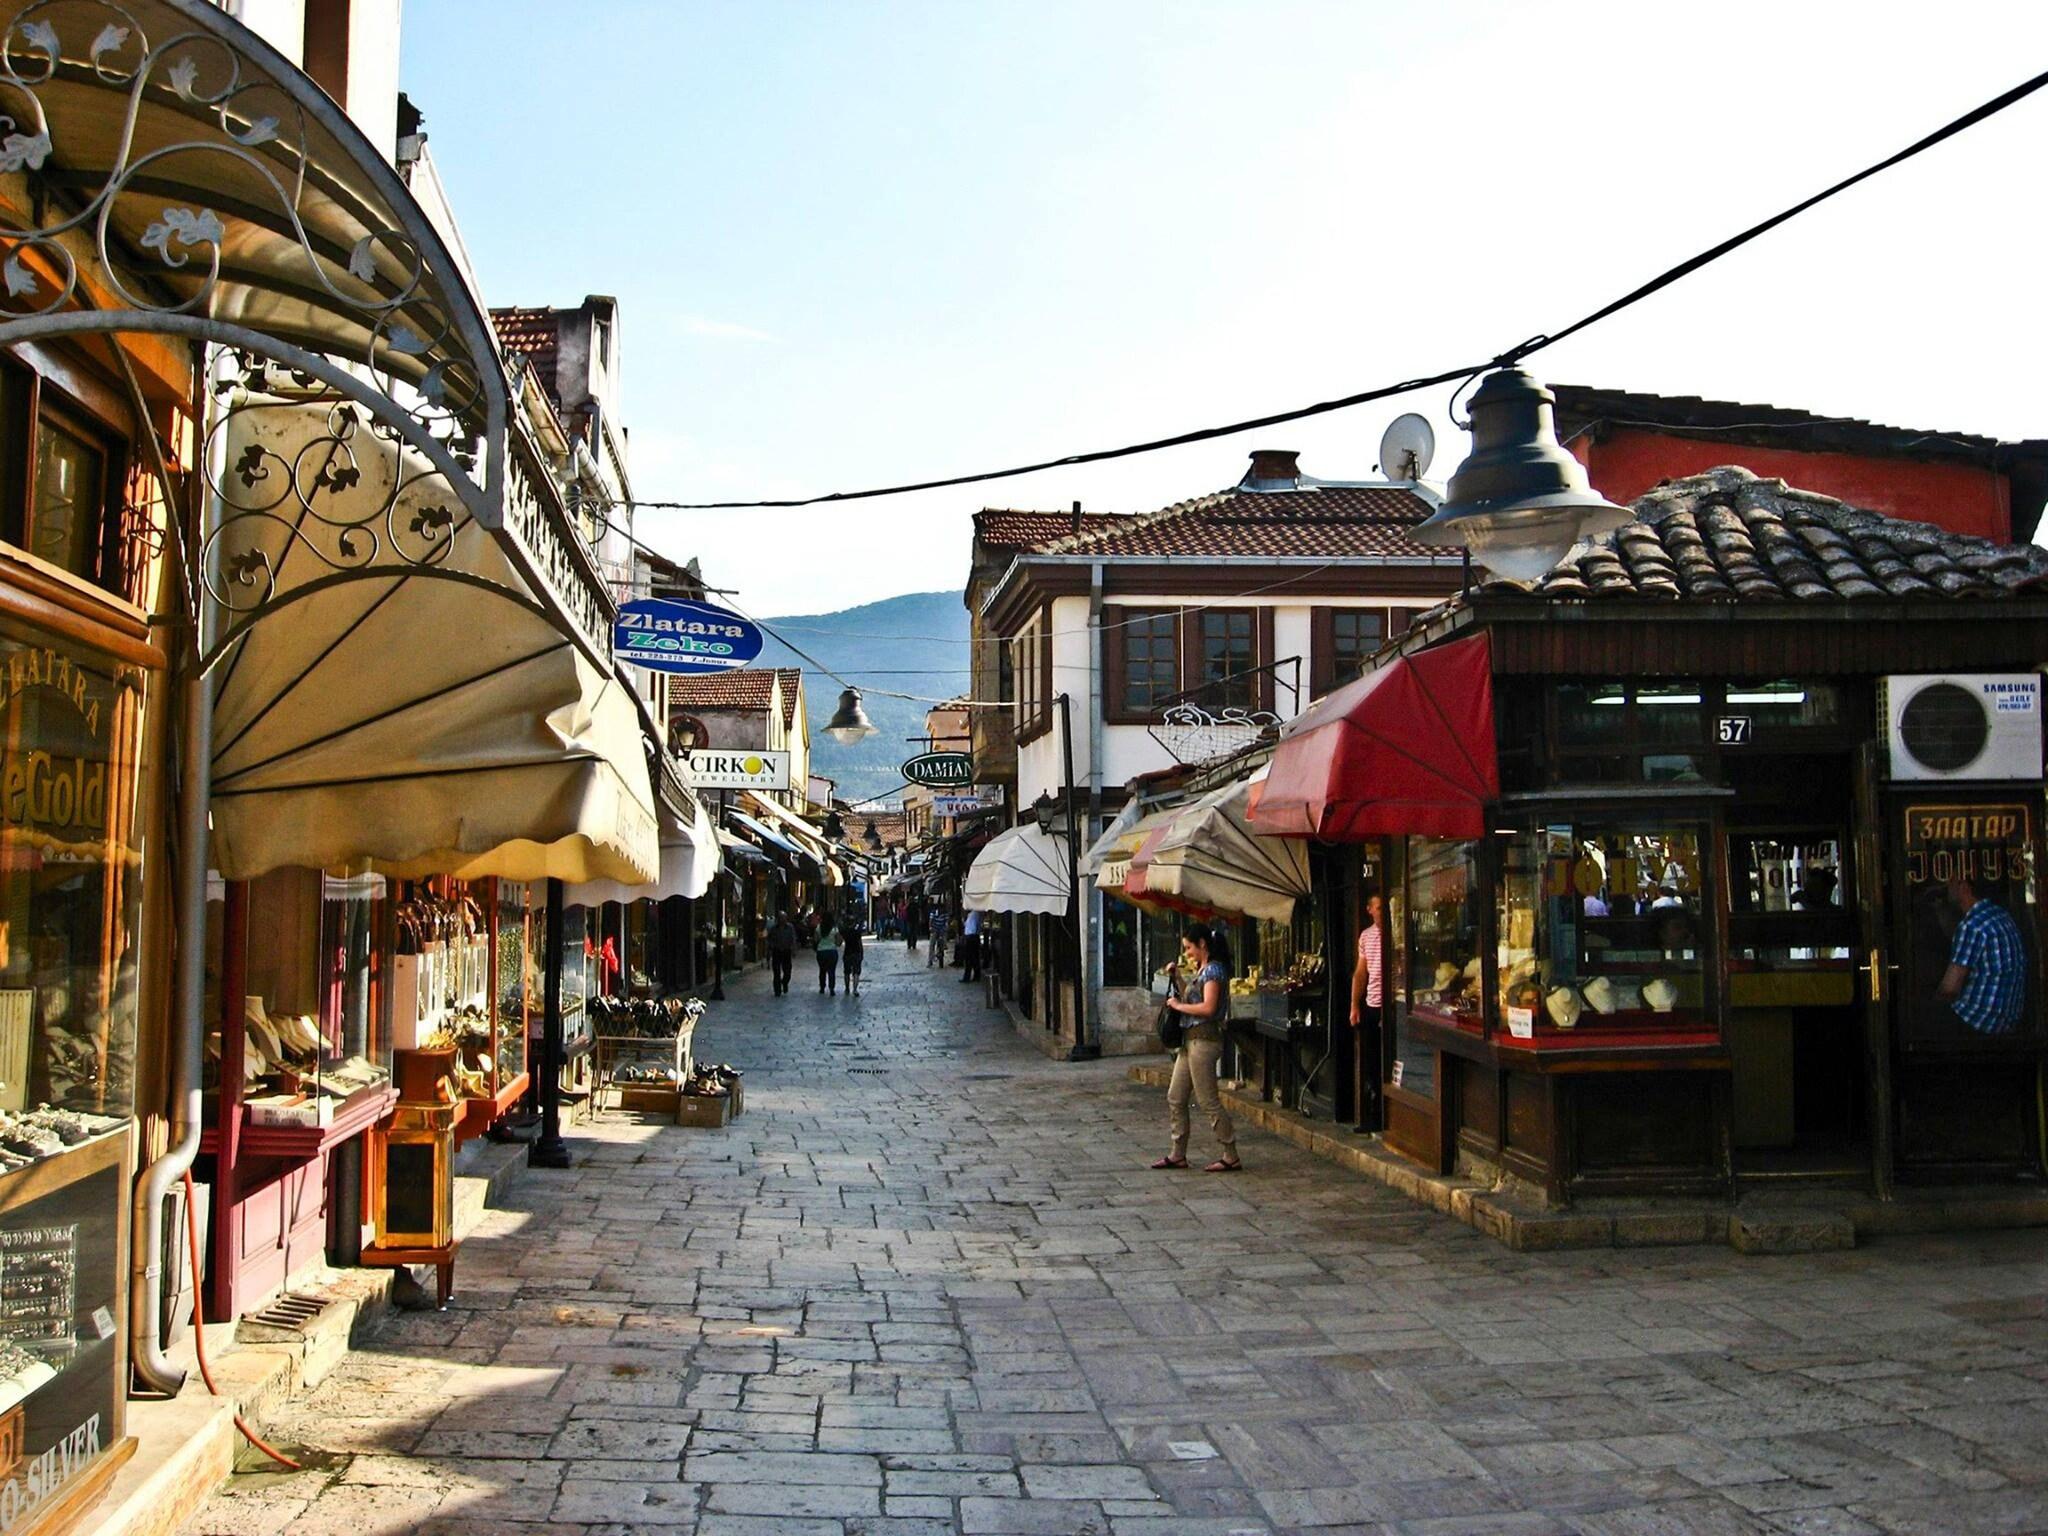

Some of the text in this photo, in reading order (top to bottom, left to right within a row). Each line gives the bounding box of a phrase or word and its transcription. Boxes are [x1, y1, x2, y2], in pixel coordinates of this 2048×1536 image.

[619, 612, 744, 638] Zlatara
[1983, 682, 2036, 693] SAMSUNG
[1719, 719, 1746, 742] 57
[690, 755, 777, 775] CIRKON
[693, 775, 776, 783] JEWELLERY
[1919, 815, 2016, 840] ЗЛАТАР
